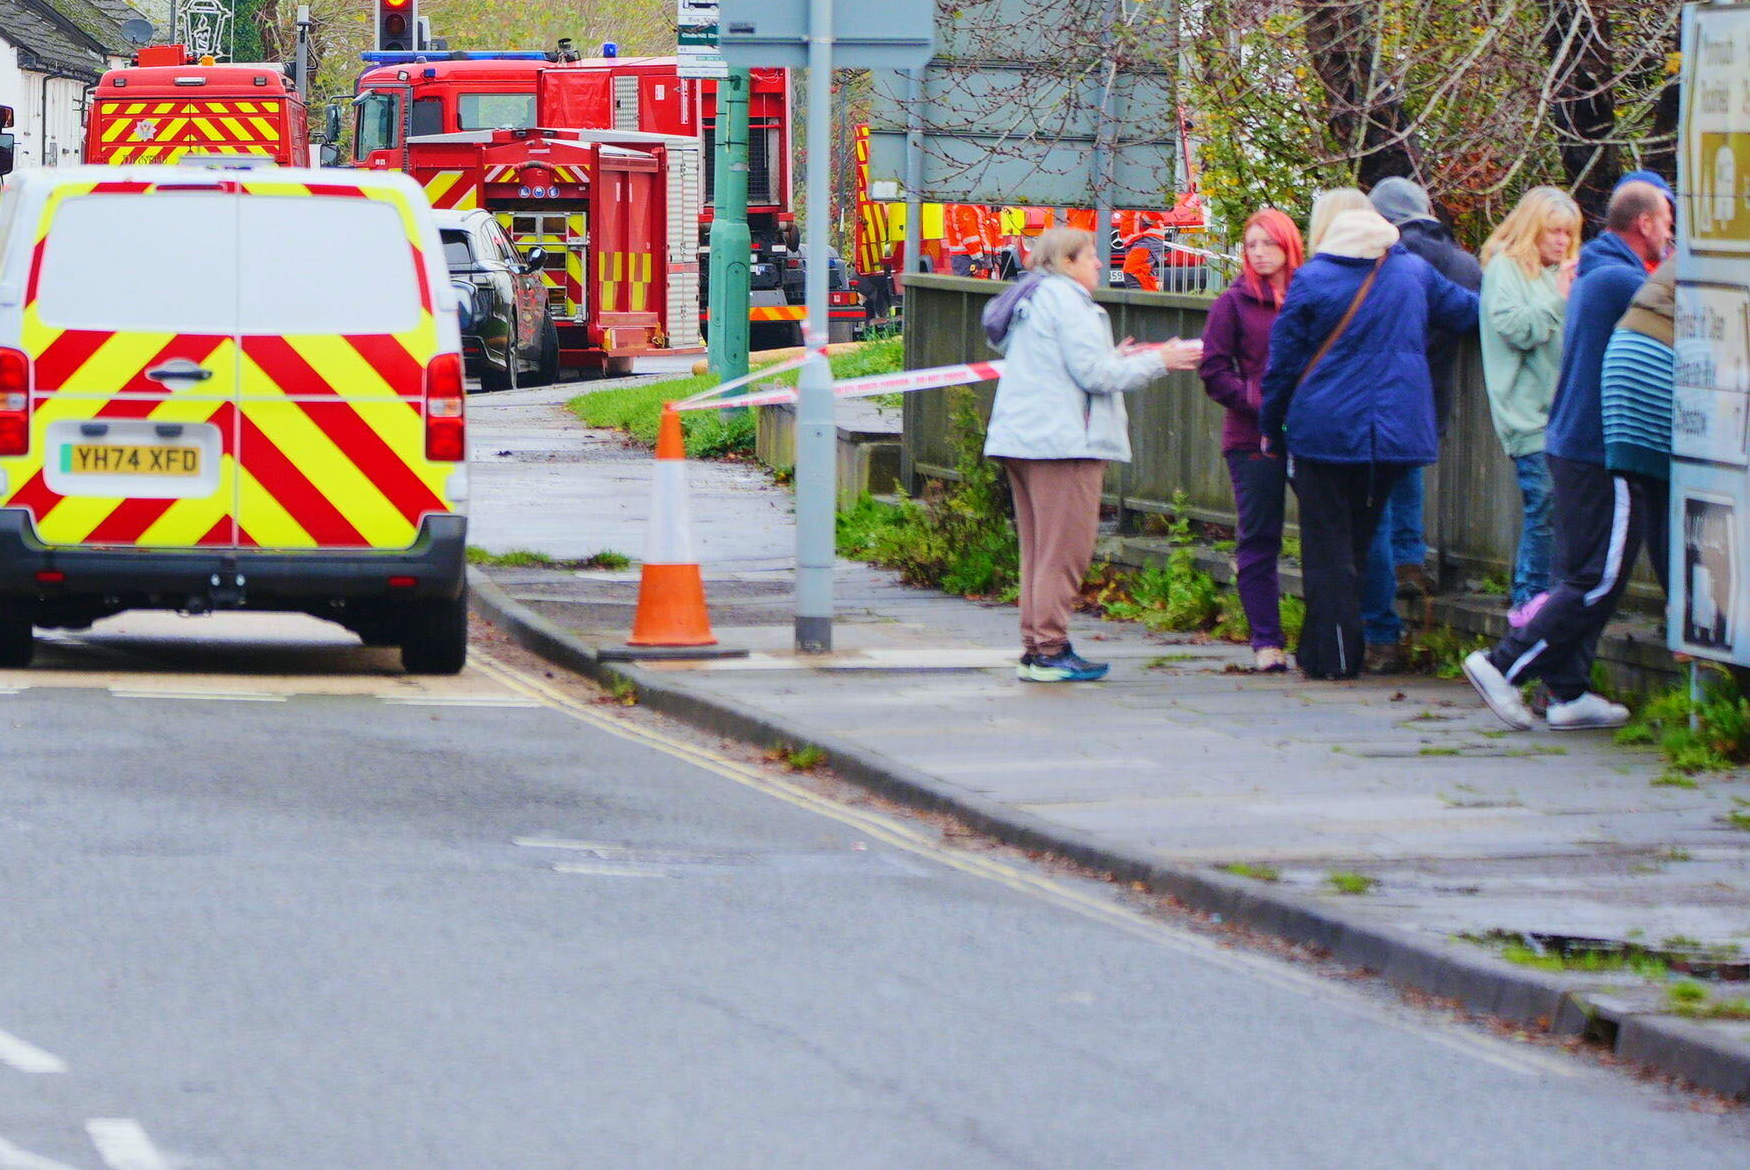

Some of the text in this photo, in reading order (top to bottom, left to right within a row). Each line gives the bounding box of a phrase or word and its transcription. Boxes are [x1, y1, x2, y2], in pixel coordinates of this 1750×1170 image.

[1109, 271, 1123, 280] 59
[78, 447, 197, 472] YH74 XFD
